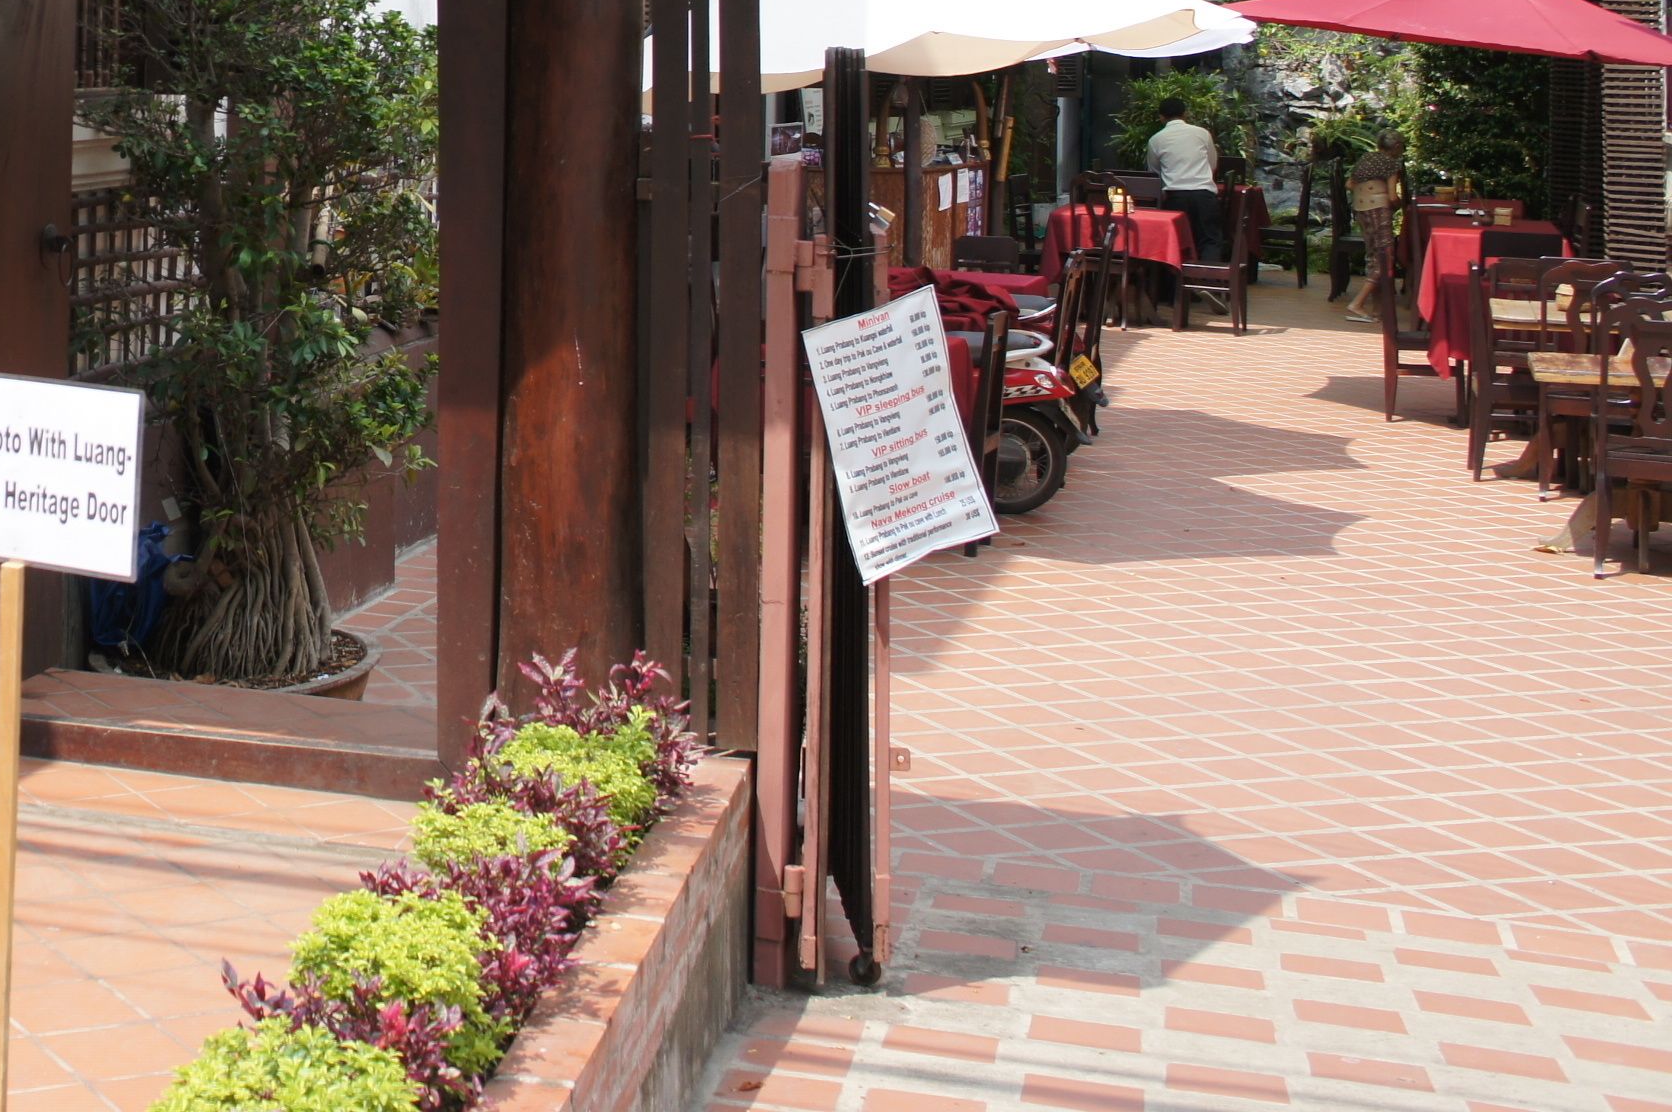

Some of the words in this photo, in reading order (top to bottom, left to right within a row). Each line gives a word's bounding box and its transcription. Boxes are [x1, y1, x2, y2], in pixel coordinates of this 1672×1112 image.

[858, 312, 889, 329] Minivan
[821, 345, 836, 354] Luang
[824, 360, 834, 368] One
[834, 358, 843, 366] day
[843, 355, 851, 363] trip
[857, 350, 865, 358] Pak
[827, 373, 842, 382] Luang
[830, 386, 845, 396] Luang
[834, 400, 849, 410] Luang
[856, 404, 872, 417] VIP
[875, 392, 910, 413] sleeping
[911, 385, 925, 397] bus
[841, 426, 855, 436] Luang
[28, 427, 66, 459] With
[844, 440, 858, 450] Luang
[872, 445, 887, 457] VIP
[889, 436, 914, 452] sitting
[915, 429, 927, 441] bus
[851, 469, 866, 478] Luang
[855, 482, 868, 492] Luang
[889, 481, 910, 494] Slow
[912, 472, 930, 486] boat
[5, 481, 79, 524] Heritage
[87, 492, 127, 525] Door
[871, 516, 892, 528] Nava
[894, 502, 927, 519] Mekong
[929, 491, 955, 506] cruise
[900, 522, 908, 530] Pak
